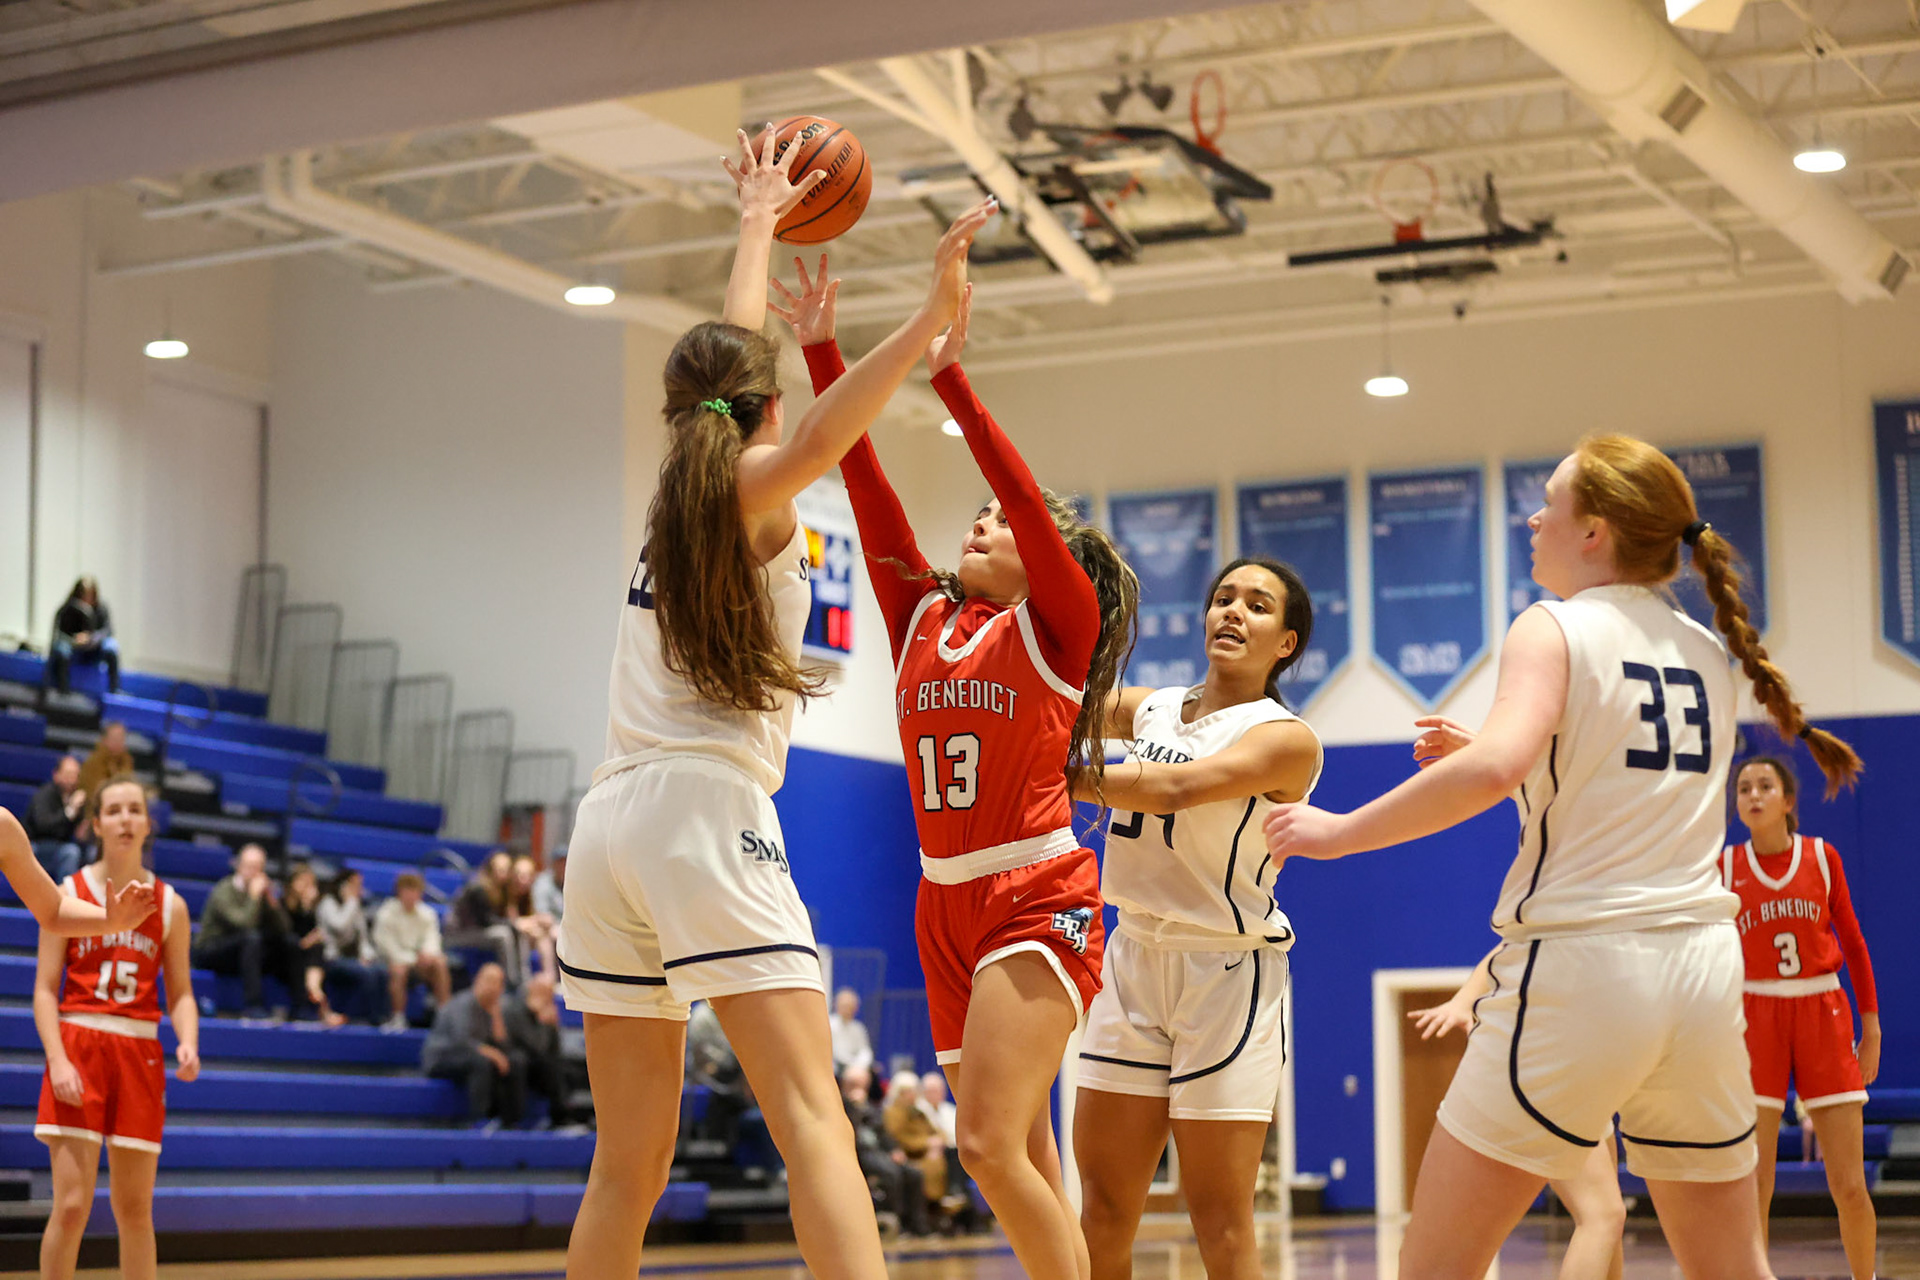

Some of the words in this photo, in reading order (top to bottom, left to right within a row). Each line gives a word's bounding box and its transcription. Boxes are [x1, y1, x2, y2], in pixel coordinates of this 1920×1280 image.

[916, 678, 1018, 720] BENEDICT
[1622, 660, 1712, 774] 33
[916, 732, 981, 812] 13
[1140, 742, 1195, 764] MAR
[740, 829, 789, 874] SMS
[1739, 909, 1758, 936] ST.
[1760, 898, 1821, 924] BENEDICT
[1773, 931, 1802, 977] 3
[94, 960, 139, 1004] 15
